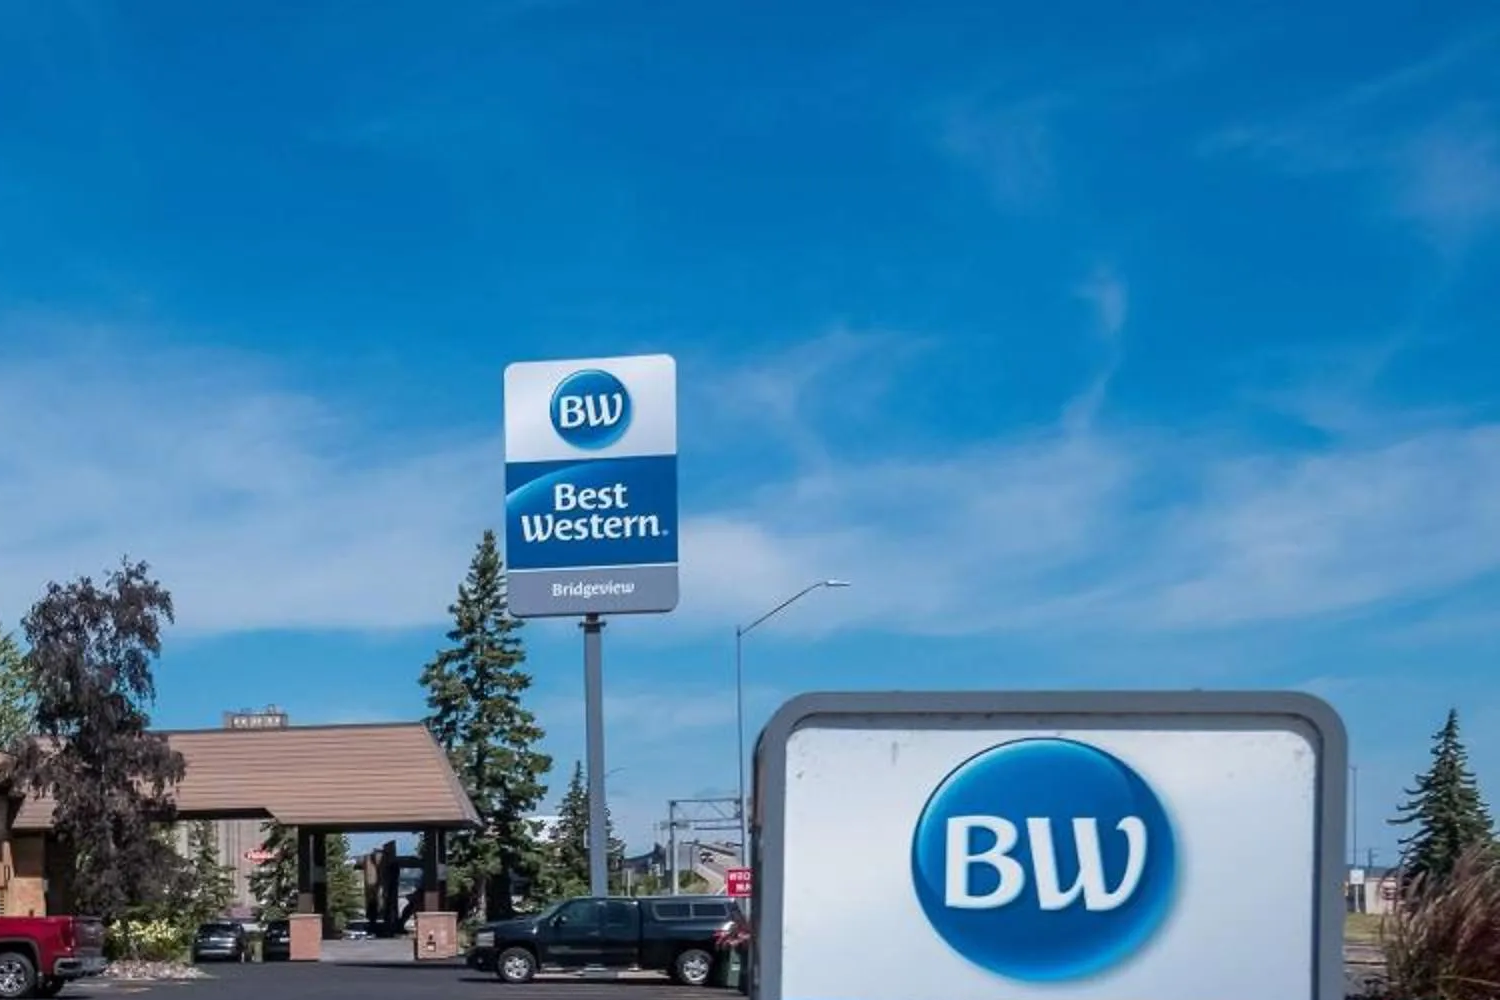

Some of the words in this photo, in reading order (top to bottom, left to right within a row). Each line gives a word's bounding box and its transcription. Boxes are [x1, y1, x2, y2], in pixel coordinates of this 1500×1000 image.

[560, 393, 623, 428] BW
[554, 483, 629, 511] Best
[552, 581, 635, 598] Bridgeview
[945, 815, 1147, 911] BW
